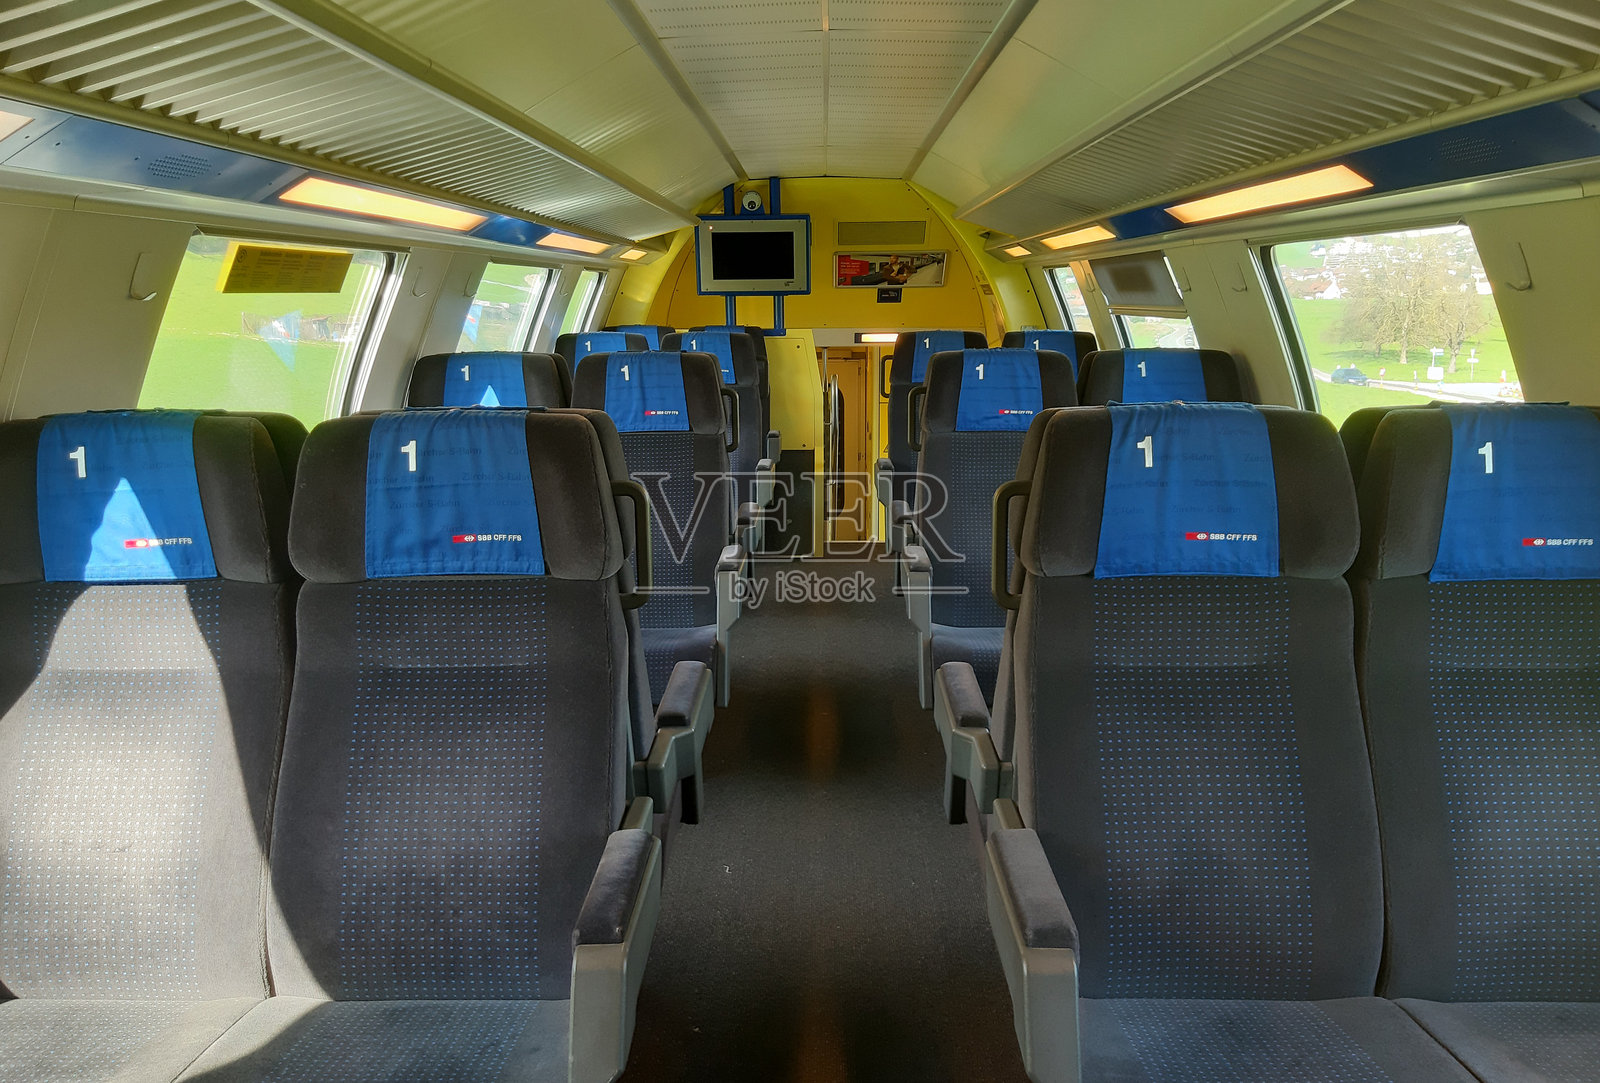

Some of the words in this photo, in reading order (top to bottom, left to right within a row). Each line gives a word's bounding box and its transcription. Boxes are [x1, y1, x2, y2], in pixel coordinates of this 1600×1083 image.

[585, 341, 592, 352] 1
[691, 340, 697, 350] 1
[924, 338, 931, 349] 1
[1033, 340, 1040, 350] 1
[461, 365, 470, 381] 1
[621, 365, 630, 381] 1
[976, 363, 985, 380] 1
[1138, 361, 1147, 377] 1
[401, 440, 417, 472] 1
[1137, 435, 1153, 468] 1
[1478, 442, 1493, 474] 1
[69, 446, 86, 478] 1
[1210, 533, 1225, 541] SBB
[1226, 533, 1242, 541] CFF
[1562, 538, 1578, 546] CFF
